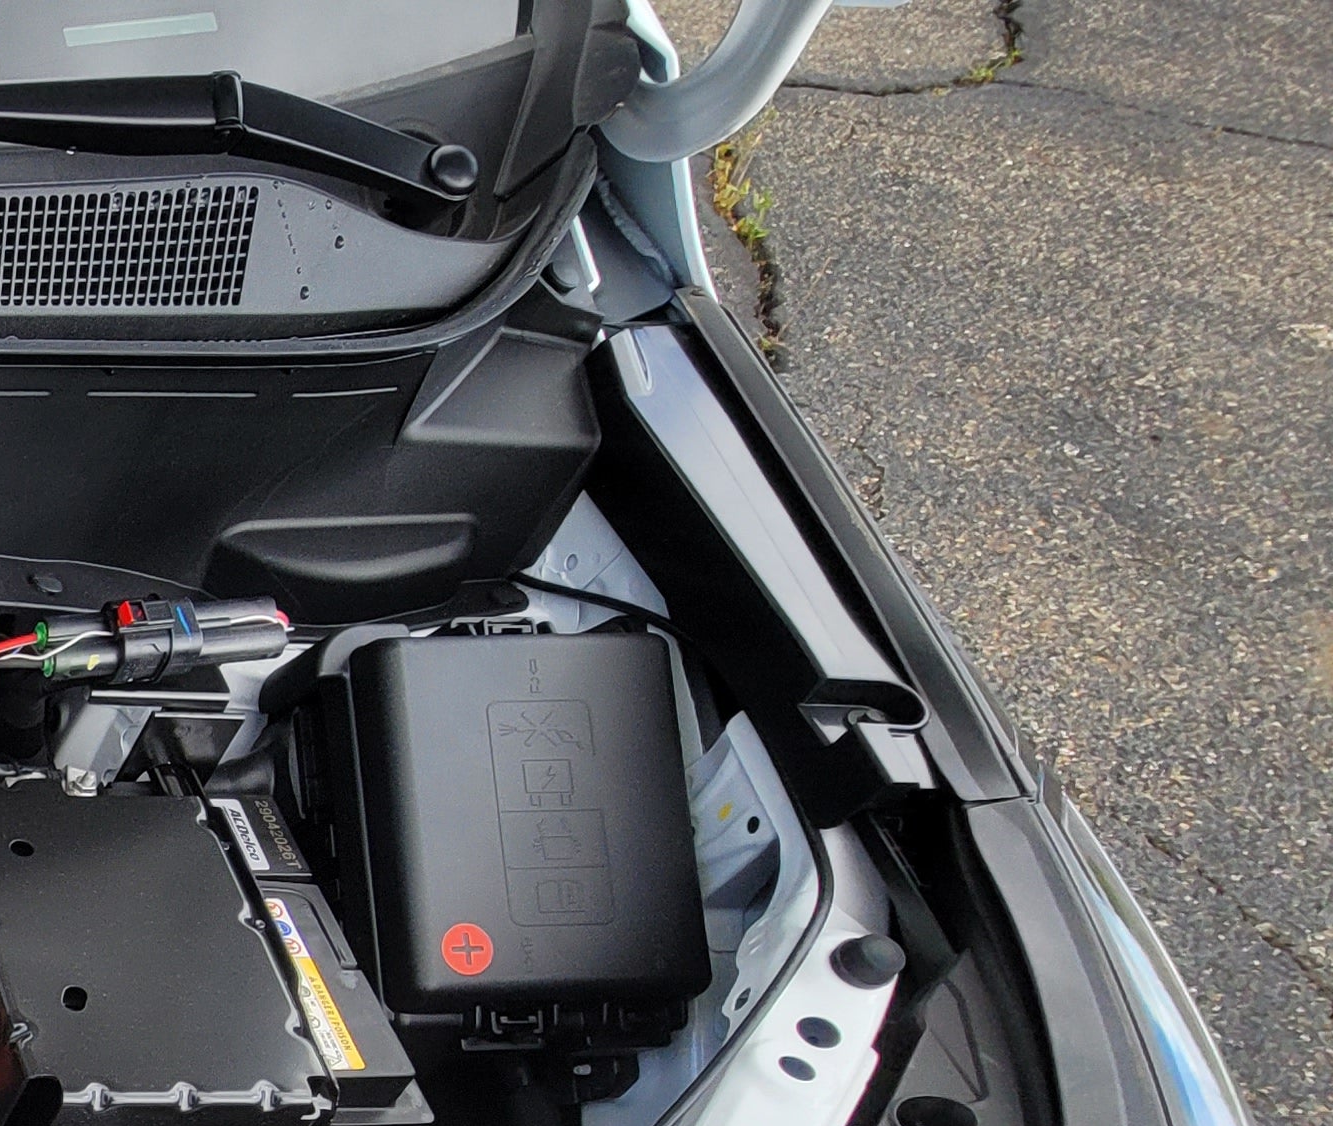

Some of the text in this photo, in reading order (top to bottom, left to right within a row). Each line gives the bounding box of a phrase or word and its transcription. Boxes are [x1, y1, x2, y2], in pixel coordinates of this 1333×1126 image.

[229, 808, 260, 861] ACDelco
[314, 984, 335, 1016] DANGER
[333, 1022, 353, 1051] POISON
